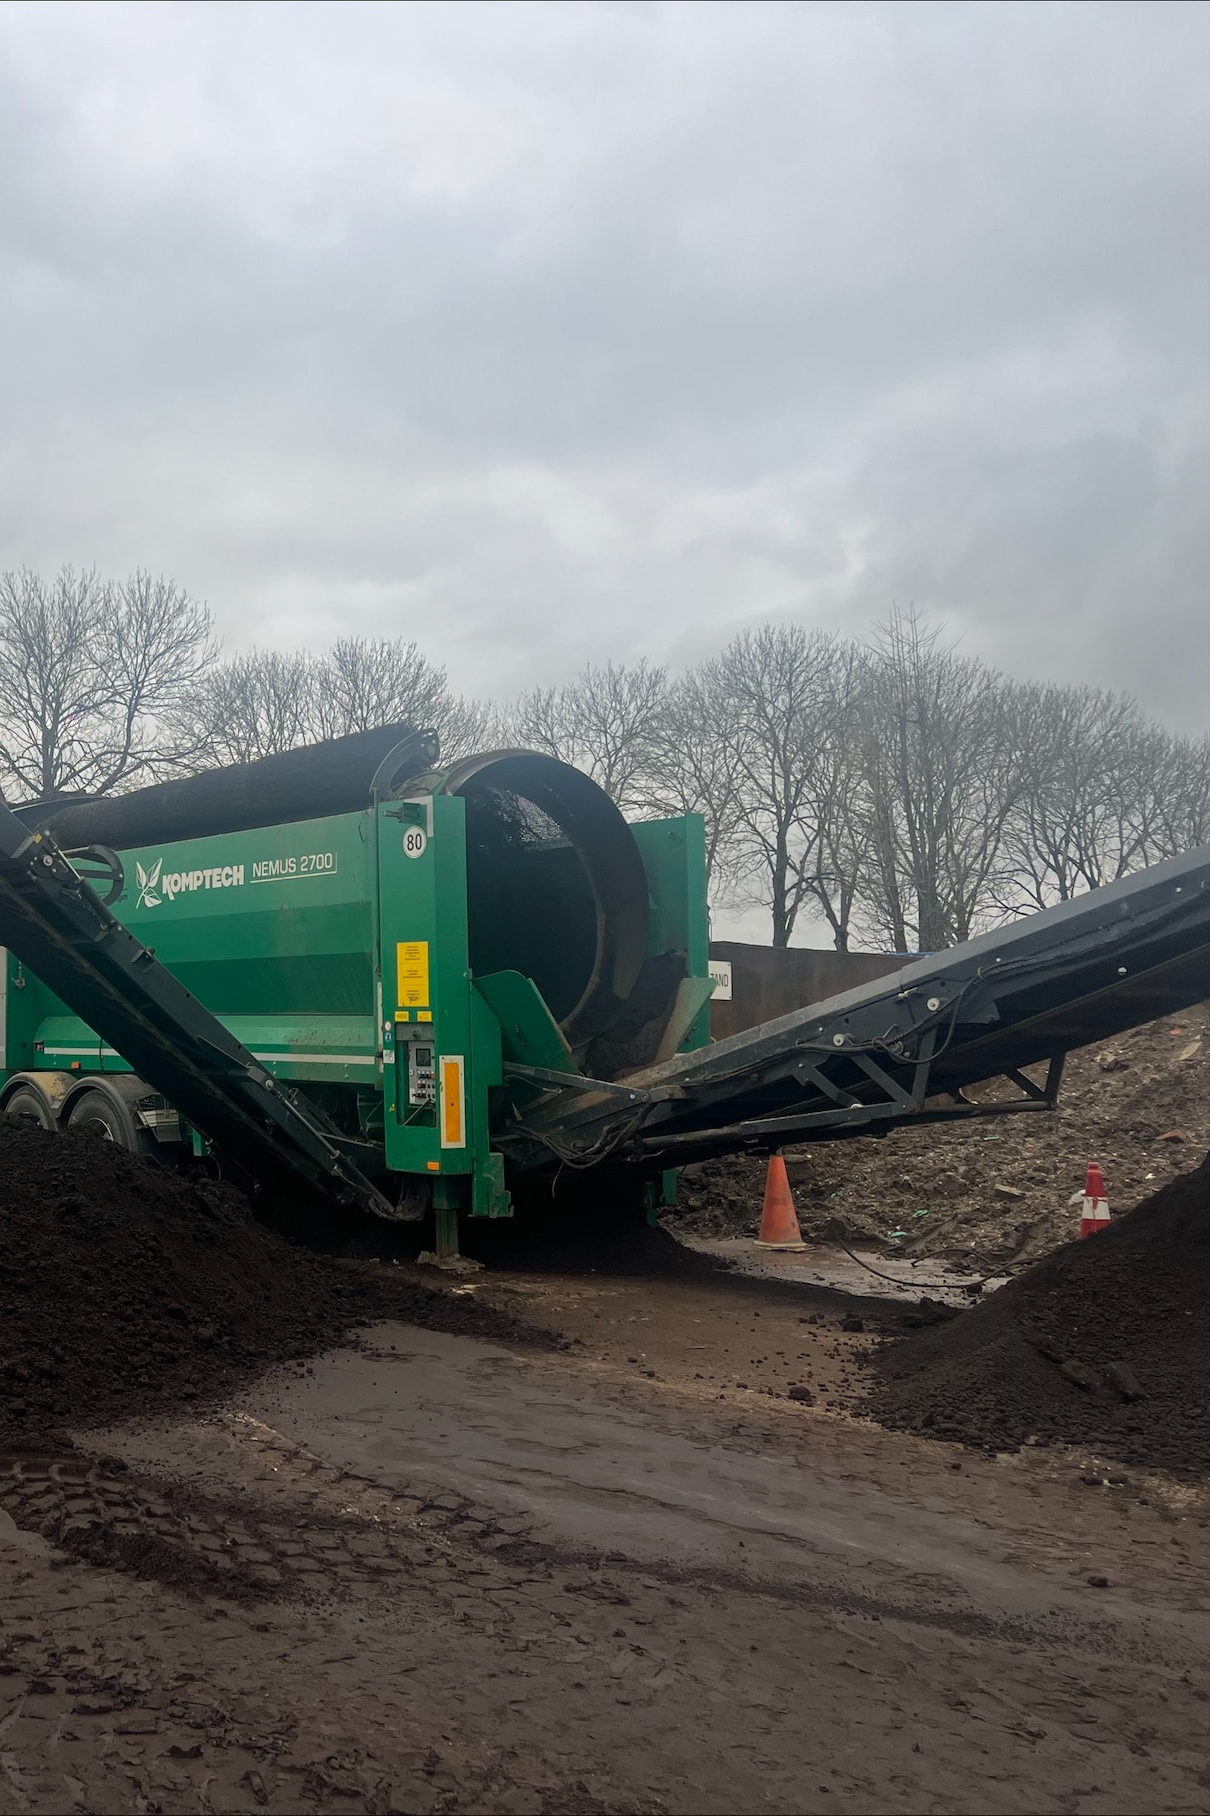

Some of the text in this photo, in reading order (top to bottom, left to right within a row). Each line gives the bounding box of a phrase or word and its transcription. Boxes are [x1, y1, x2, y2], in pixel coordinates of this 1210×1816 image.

[407, 833, 422, 851] 80
[252, 852, 334, 878] NEMUS 2700
[162, 864, 245, 901] KOMPTECH
